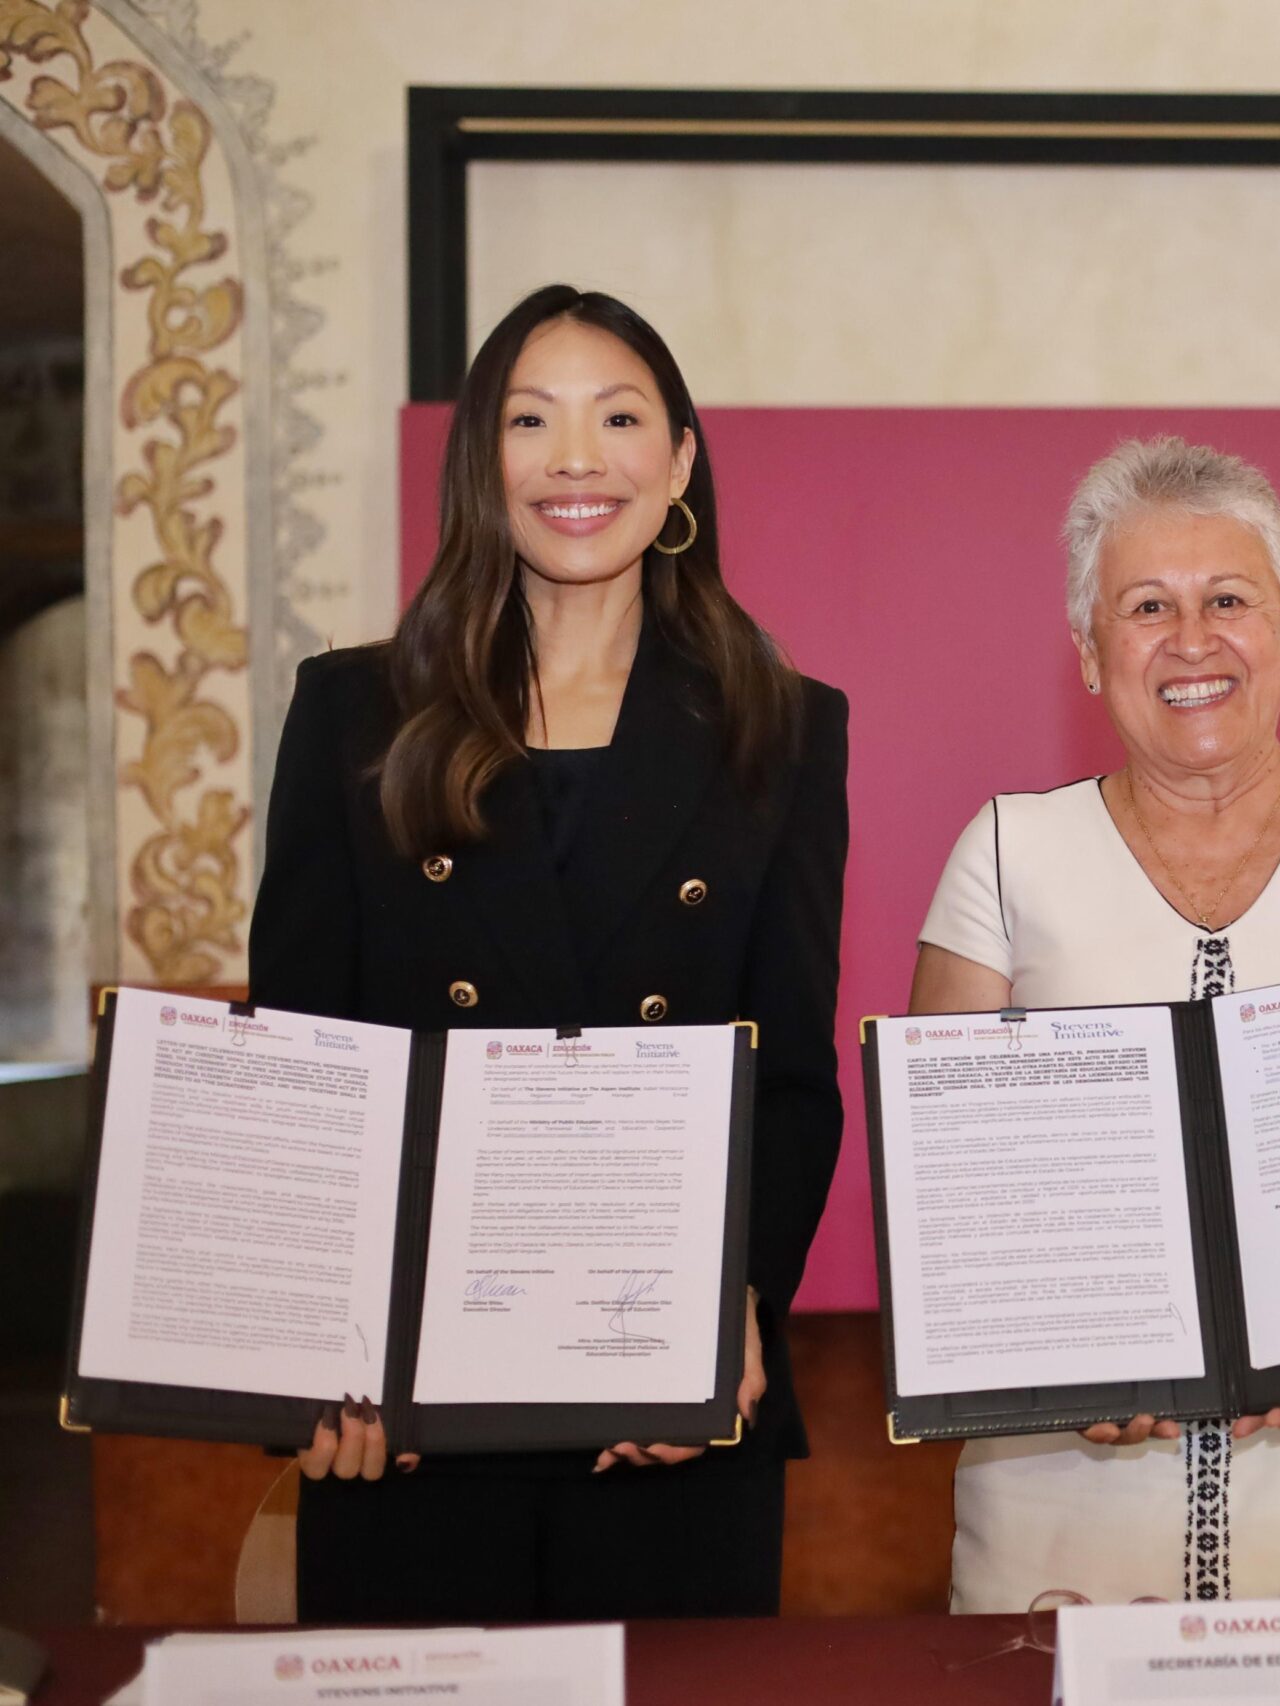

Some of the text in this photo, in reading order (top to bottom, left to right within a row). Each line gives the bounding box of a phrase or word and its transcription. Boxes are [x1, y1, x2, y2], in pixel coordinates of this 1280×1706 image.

[181, 1013, 269, 1032] OAXACA EDUCACIÓN
[1051, 1021, 1112, 1031] Stevens
[314, 1029, 352, 1042] Stevens
[926, 1027, 1012, 1038] OAXACA EDUCACIÓN
[1054, 1029, 1124, 1039] Initiative
[314, 1037, 359, 1052] Initiative
[506, 1045, 542, 1053] OAXACA
[636, 1041, 674, 1050] Stevens
[636, 1050, 680, 1058] Initiative
[312, 1656, 400, 1674] OAXACA
[1148, 1655, 1237, 1671] SECRETARÍA
[1242, 1656, 1262, 1668] DE
[317, 1684, 459, 1698] STEVENS INITIATIVE
